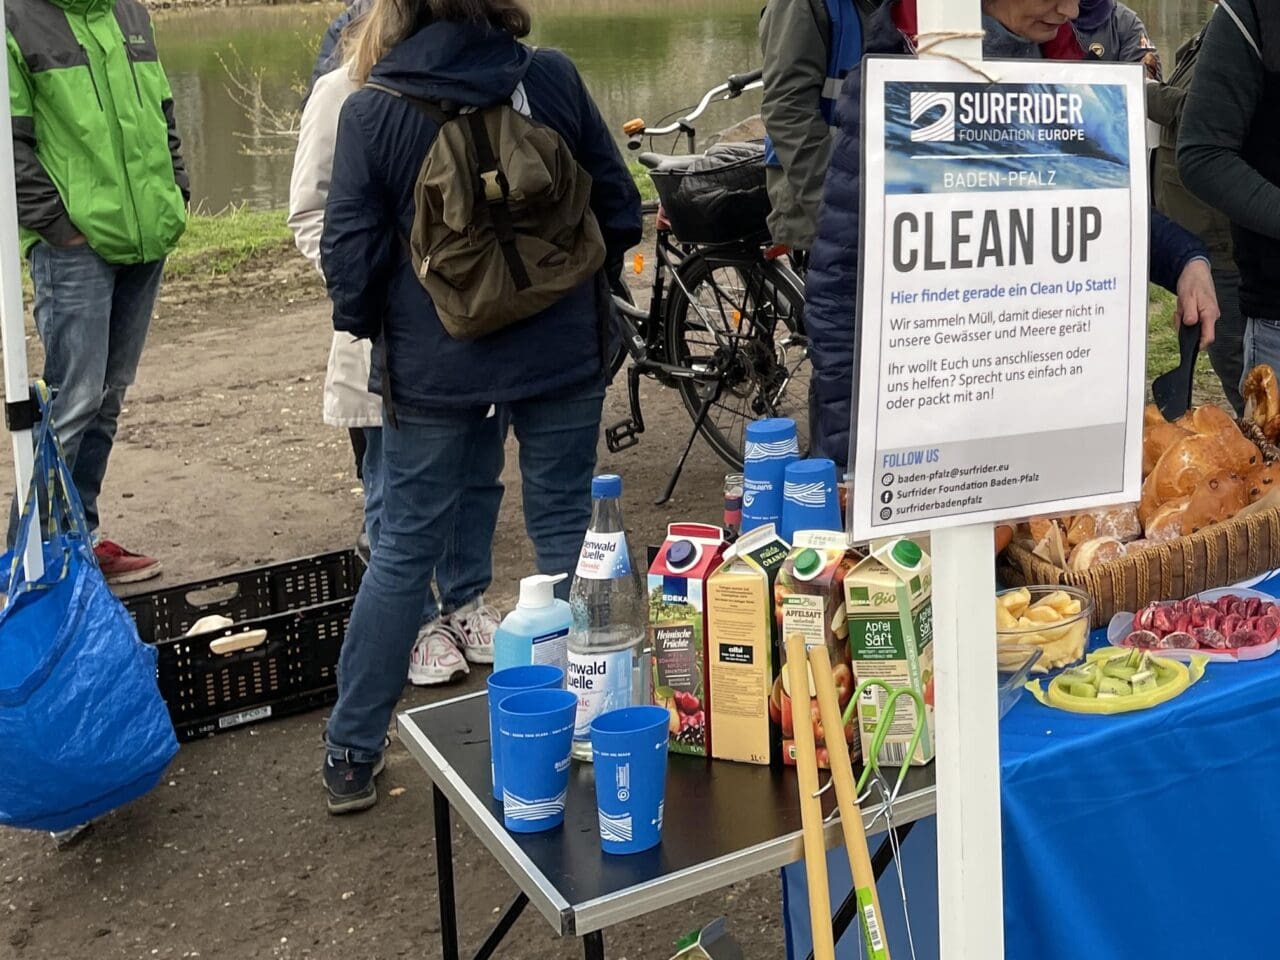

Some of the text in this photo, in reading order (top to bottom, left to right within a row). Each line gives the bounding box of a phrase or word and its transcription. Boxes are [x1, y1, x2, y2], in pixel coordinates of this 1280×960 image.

[959, 92, 1084, 124] SURFRIDER
[959, 129, 1085, 141] FOUNDATION EUROPE
[944, 170, 1057, 188] BADEN-PFALZ
[892, 206, 1102, 273] CLEAN UP
[890, 277, 1117, 304] Hier findet gerade ein Clean Up Statt!
[889, 304, 1105, 331] Wir sammeln Müll, damit dieser nicht in
[889, 320, 1091, 348] unsere Gewässer und Meere gerät!
[888, 346, 1091, 375] Ihr wollt Euch uns anschliessen oder
[887, 364, 1083, 392] uns helfen? Sprecht uns einfach an
[886, 387, 994, 410] oder packt mit an!
[883, 448, 940, 468] FOLLOW US
[898, 463, 1009, 484] baden-pfalz@surfrider.eu
[897, 473, 1039, 499] Surfrider Foundation Baden-Pfalz
[896, 495, 983, 515] surfriderbadenpfalz
[662, 594, 688, 603] EDEKA
[871, 591, 896, 607] Bio
[785, 609, 822, 619] APFELSAFT
[656, 628, 692, 640] Heimische
[865, 620, 891, 636] Apfel
[662, 638, 689, 649] Früchte
[865, 633, 893, 647] Saft
